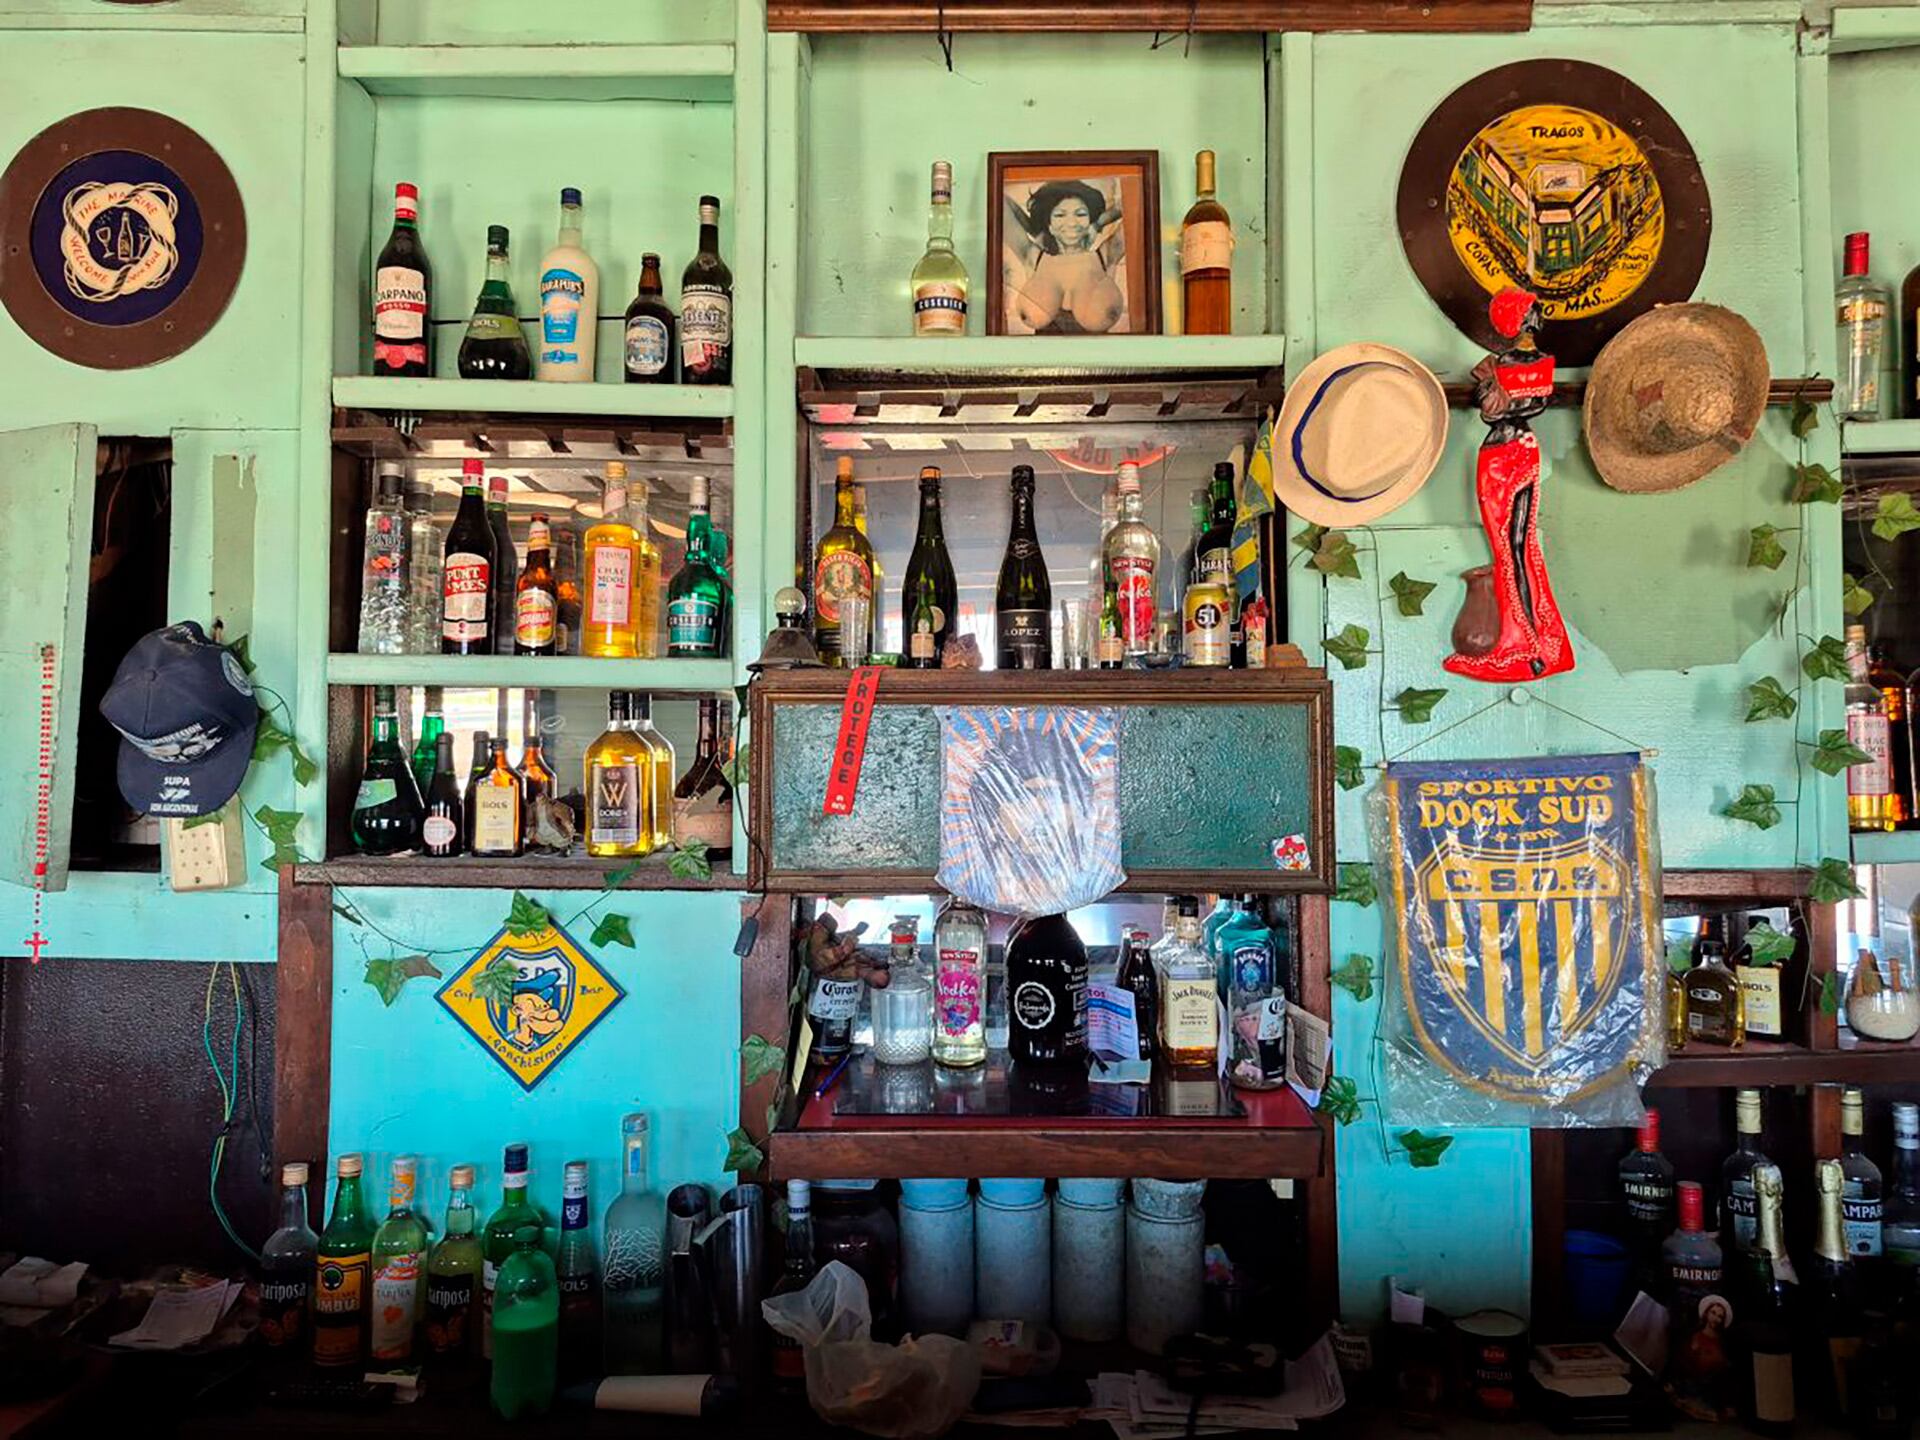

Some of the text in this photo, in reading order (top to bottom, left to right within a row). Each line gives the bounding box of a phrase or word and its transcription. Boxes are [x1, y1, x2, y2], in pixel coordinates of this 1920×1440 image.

[1527, 125, 1585, 138] TRAGOS
[79, 198, 102, 220] THE
[70, 232, 110, 285] WELCOME
[1464, 241, 1501, 277] COPAS
[377, 289, 424, 302] ARPANO
[447, 565, 481, 582] PUNT
[1197, 607, 1217, 626] 51
[837, 669, 874, 785] PROTEGE
[163, 776, 191, 786] SUPA
[1418, 775, 1614, 796] SPORTIVO
[1419, 794, 1614, 829] DOCK SUD
